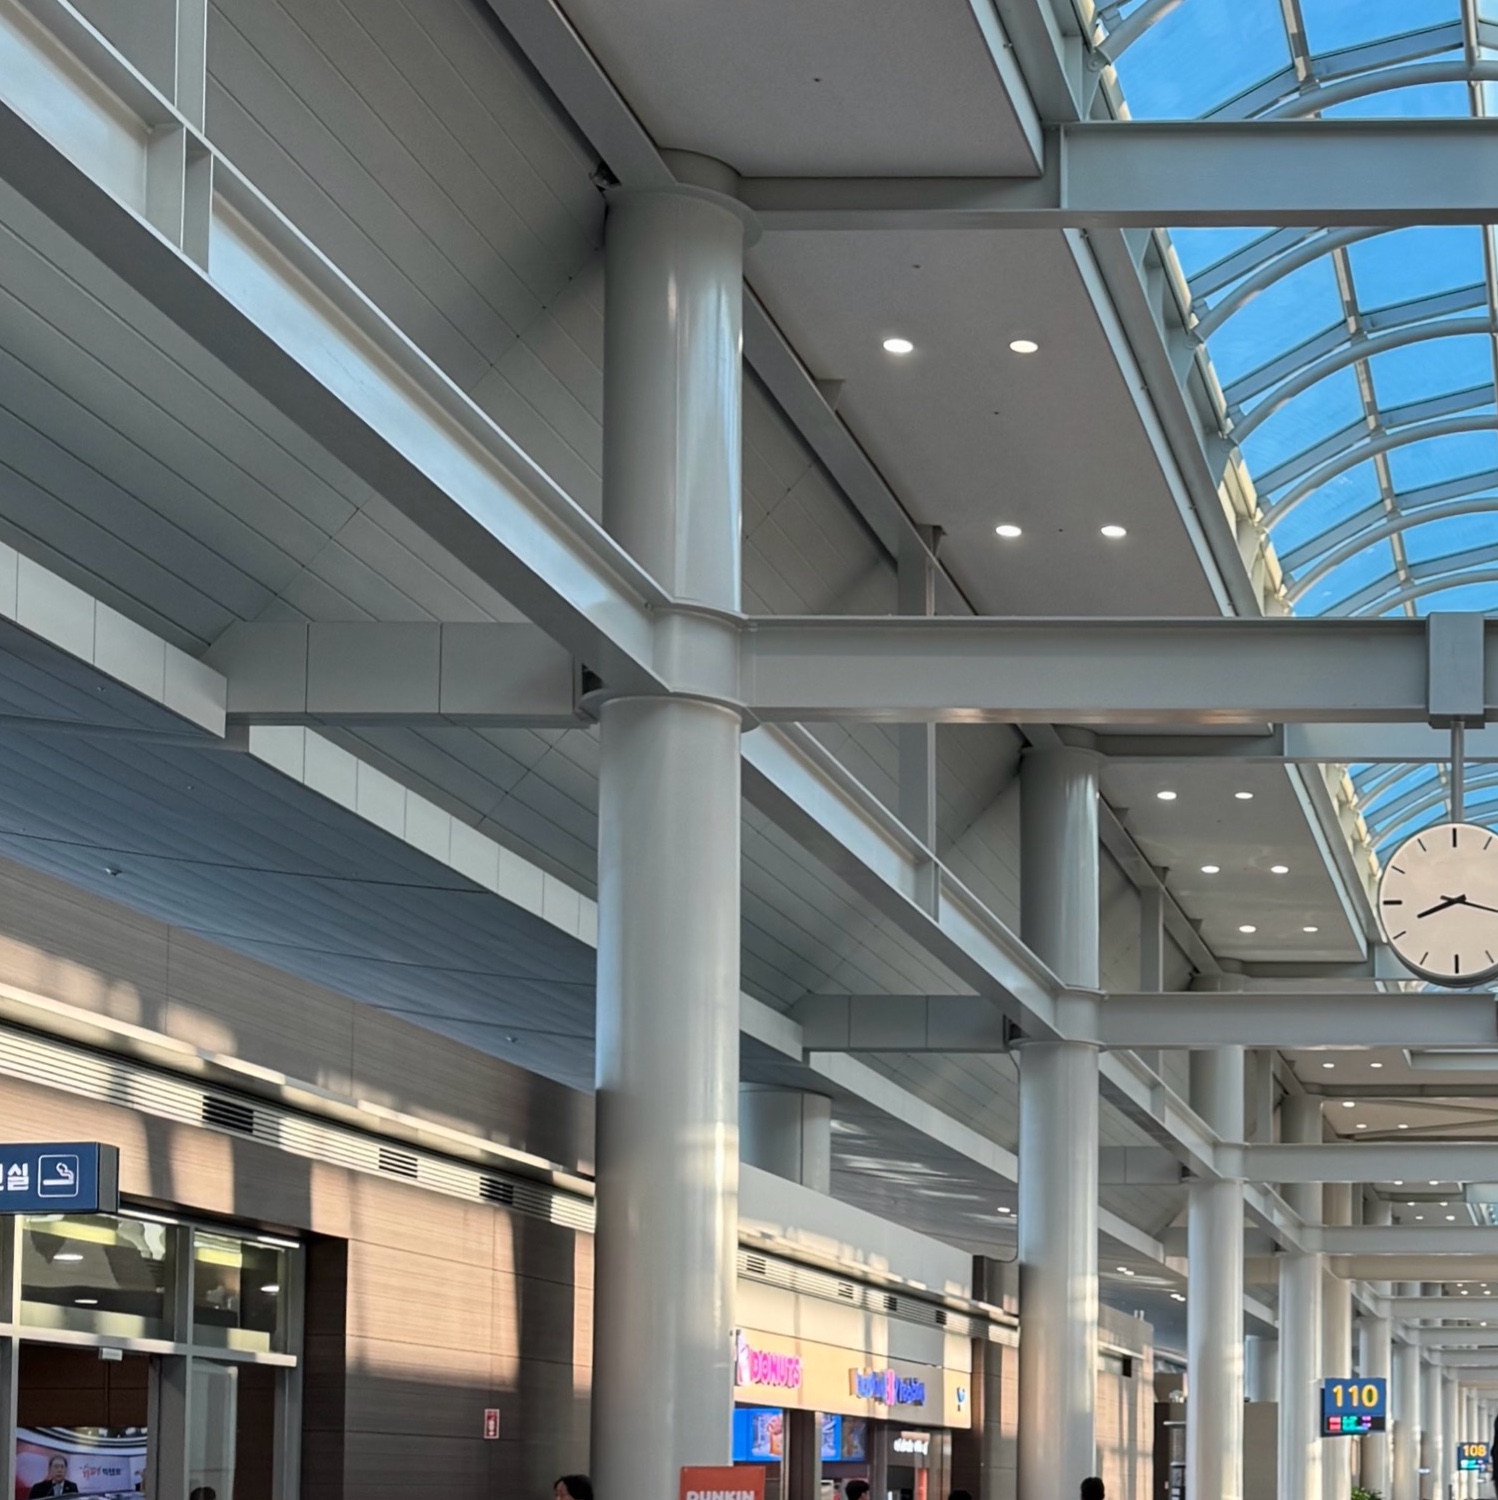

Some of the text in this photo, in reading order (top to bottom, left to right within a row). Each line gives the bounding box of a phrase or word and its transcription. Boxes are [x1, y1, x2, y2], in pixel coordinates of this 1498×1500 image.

[749, 1350, 802, 1388] DONUTS
[1333, 1385, 1378, 1407] 110
[1463, 1444, 1487, 1457] 108
